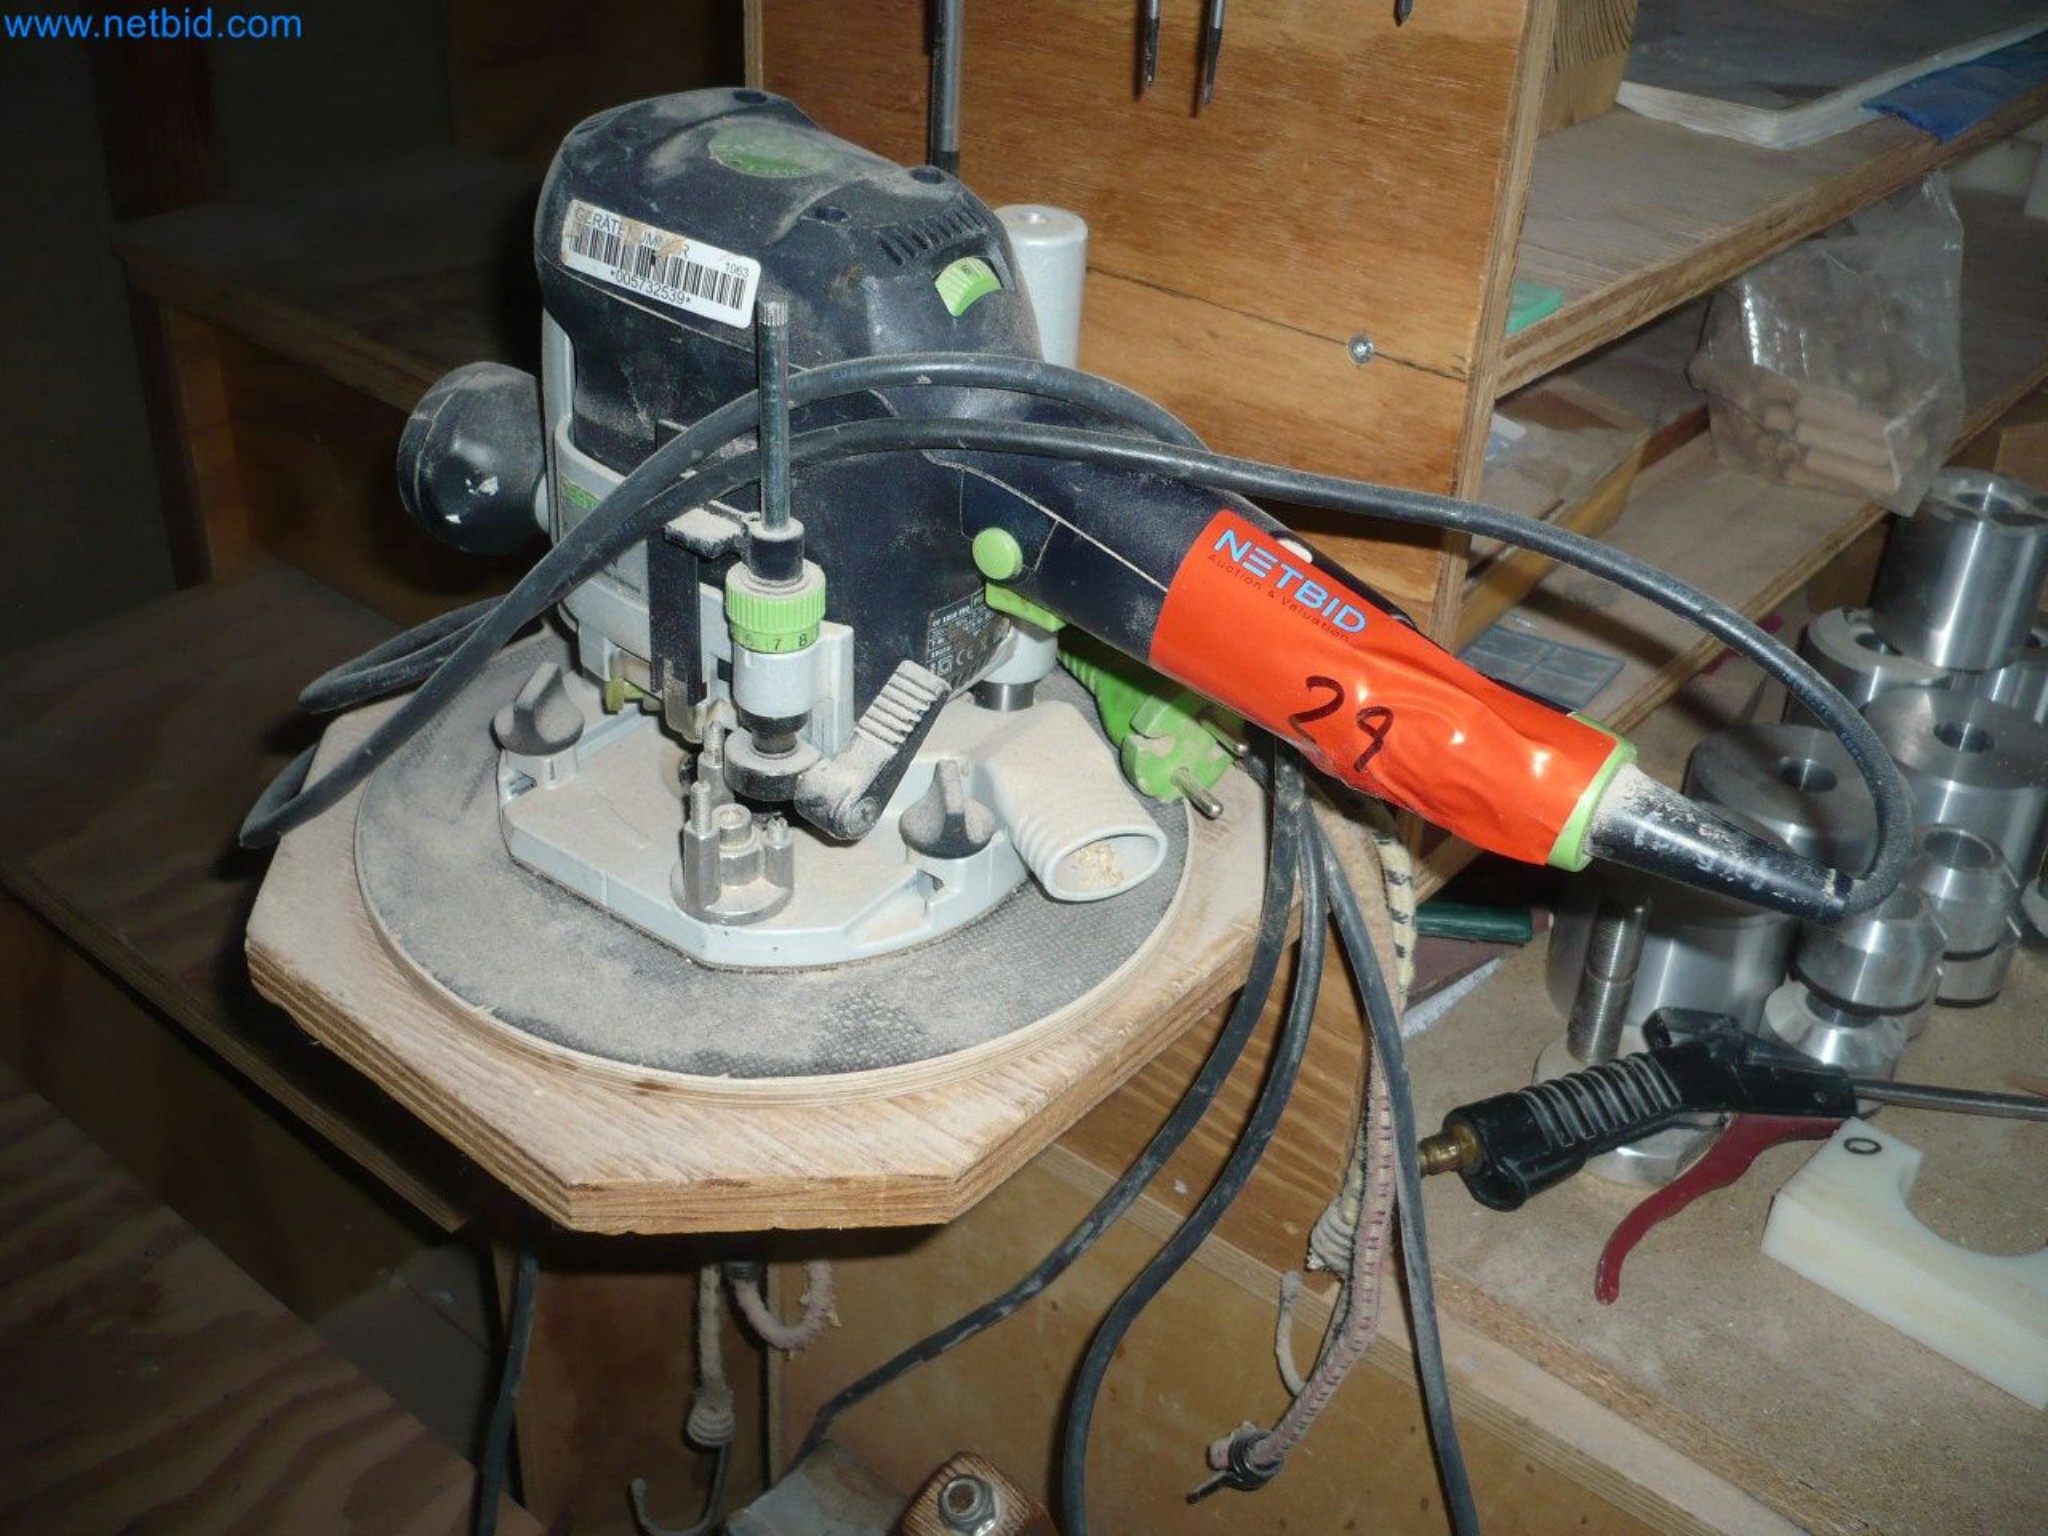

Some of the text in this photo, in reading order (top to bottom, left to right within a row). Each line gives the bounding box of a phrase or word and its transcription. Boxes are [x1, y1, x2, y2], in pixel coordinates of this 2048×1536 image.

[1207, 553, 1263, 589] Auction
[1213, 528, 1368, 634] NETBID
[773, 638, 783, 651] 7
[798, 632, 808, 648] 8
[1287, 674, 1394, 773] 29
